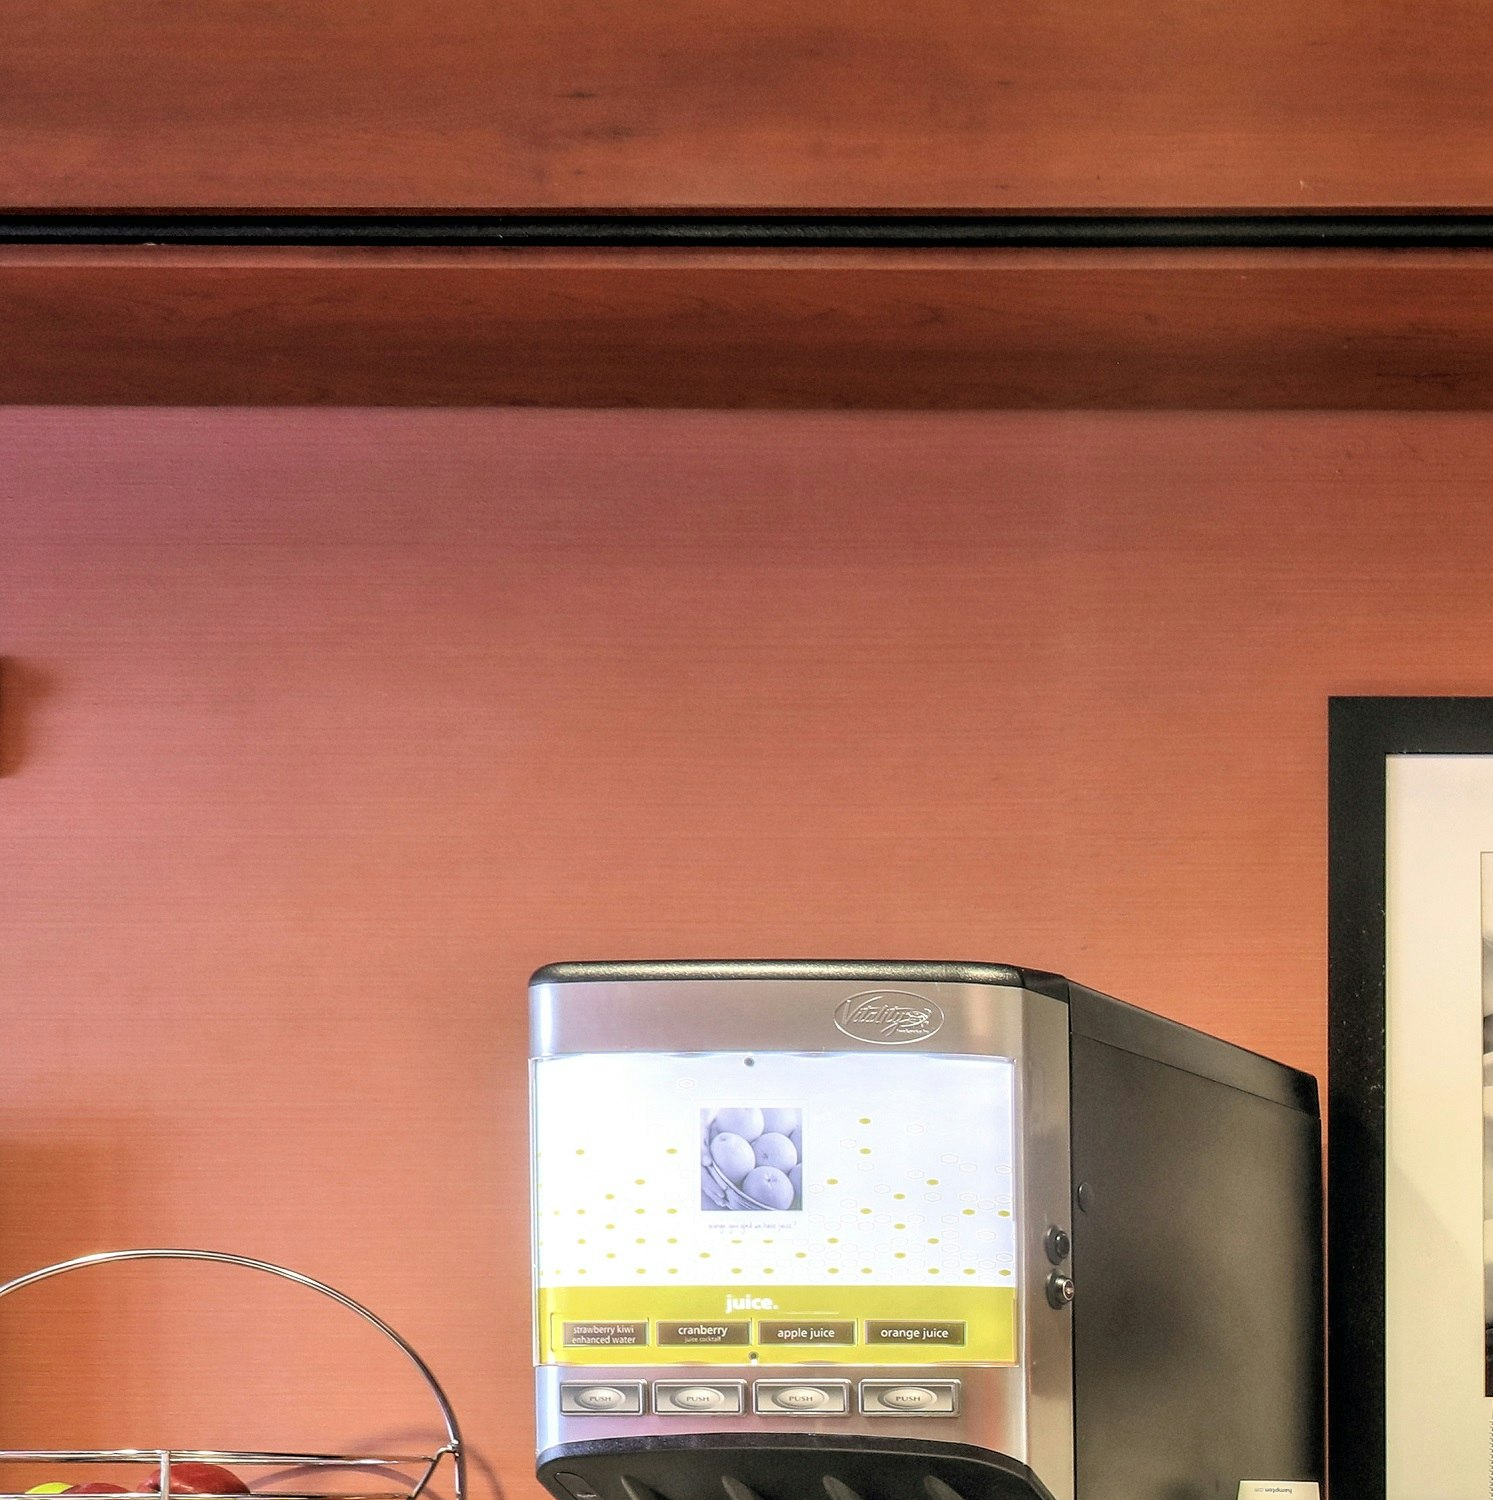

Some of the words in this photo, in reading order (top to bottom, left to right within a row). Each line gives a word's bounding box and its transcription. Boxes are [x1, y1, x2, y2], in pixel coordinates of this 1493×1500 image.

[726, 1294, 778, 1313] juice.
[573, 1325, 615, 1337] strawberry
[617, 1324, 634, 1334] kiwi
[678, 1324, 728, 1337] cranberry
[777, 1327, 807, 1340] apple
[809, 1327, 835, 1340] juice
[880, 1328, 920, 1340] orange
[922, 1327, 949, 1341] juice
[572, 1335, 610, 1344] enhanced
[612, 1335, 636, 1344] water
